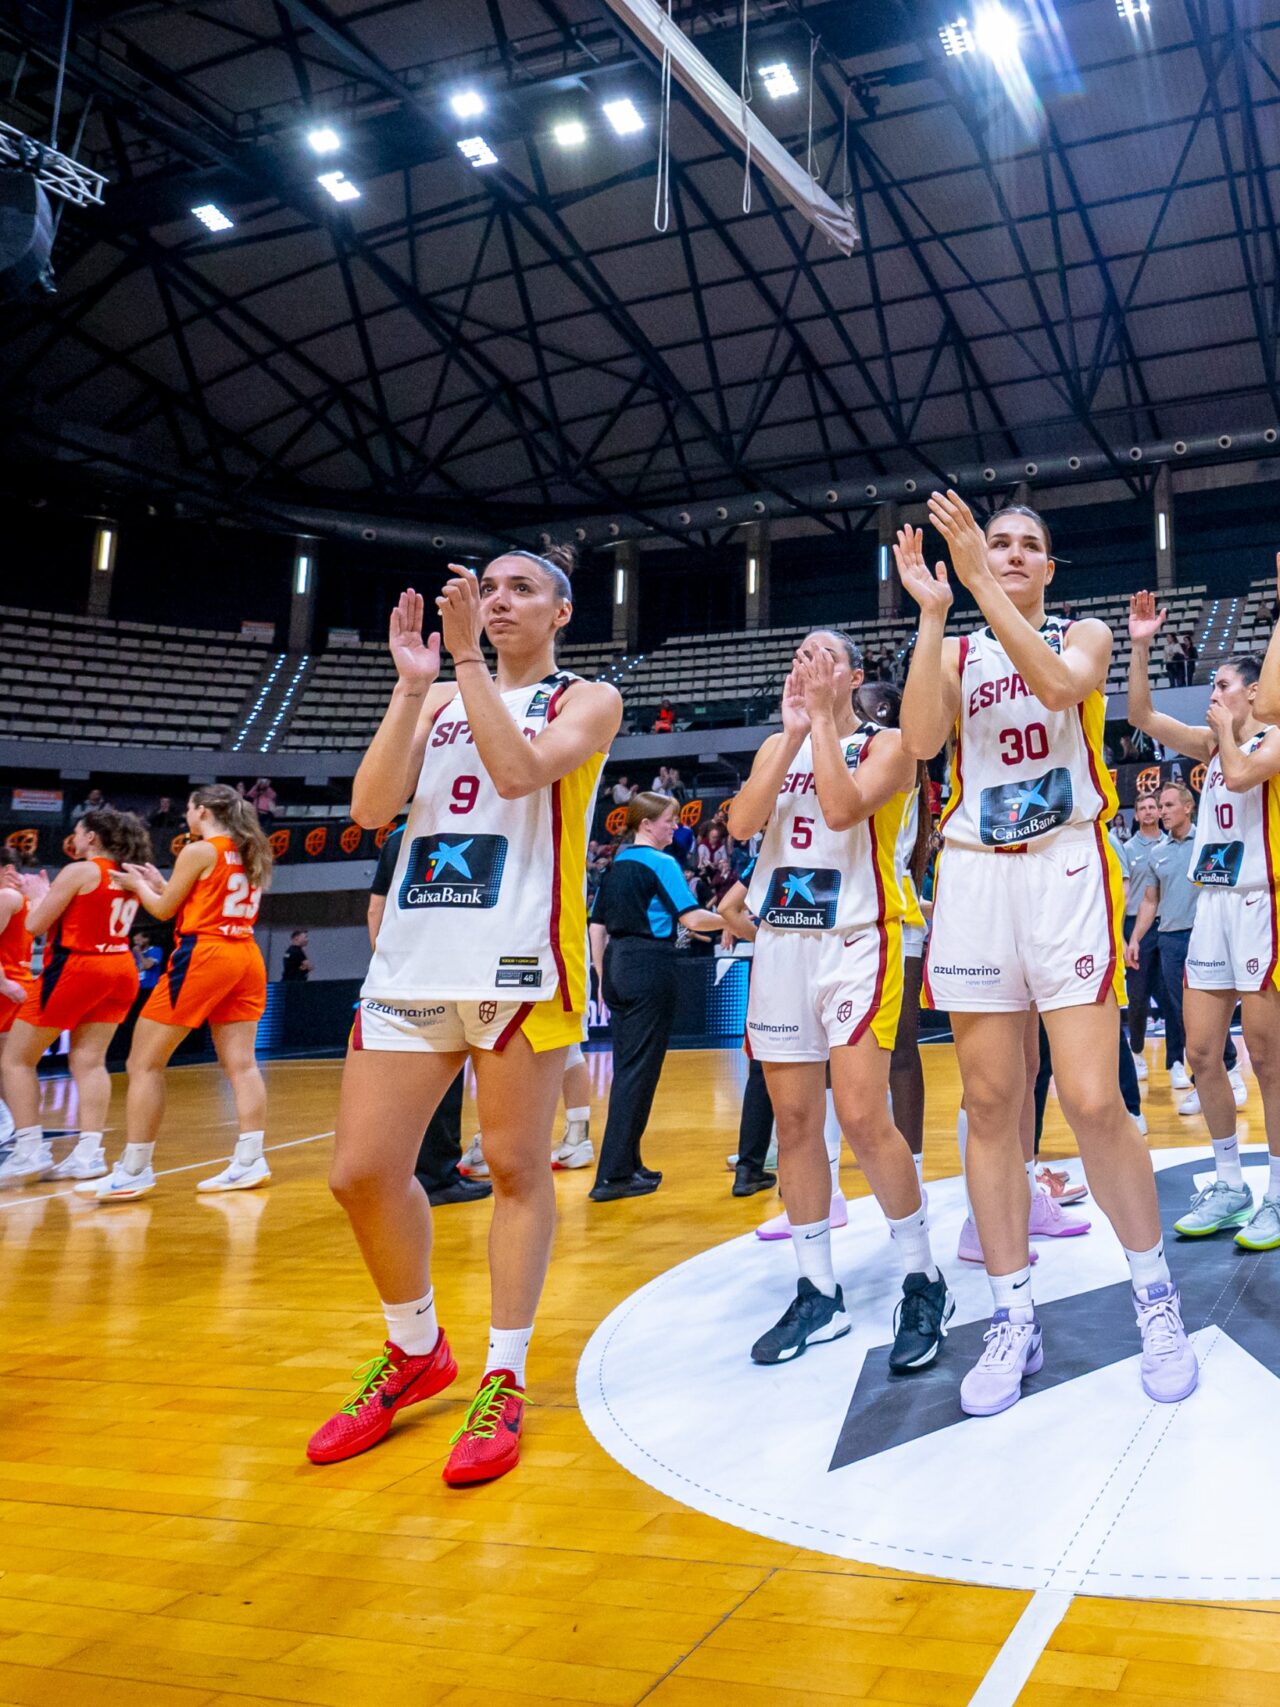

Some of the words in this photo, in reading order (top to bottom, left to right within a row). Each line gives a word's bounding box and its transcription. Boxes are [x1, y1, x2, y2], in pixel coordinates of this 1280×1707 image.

[969, 673, 1034, 718] ESPA
[1000, 722, 1049, 766] 30
[449, 775, 480, 814] 9
[992, 813, 1057, 842] CaixaBank
[1215, 803, 1233, 829] 10
[790, 816, 815, 850] 5
[407, 886, 483, 904] CaixaBank
[109, 897, 139, 938] 19
[766, 910, 824, 926] CaixaBank
[934, 965, 1000, 976] azulmarino
[367, 1001, 445, 1018] azulmarino
[749, 1022, 799, 1033] azulmarino
